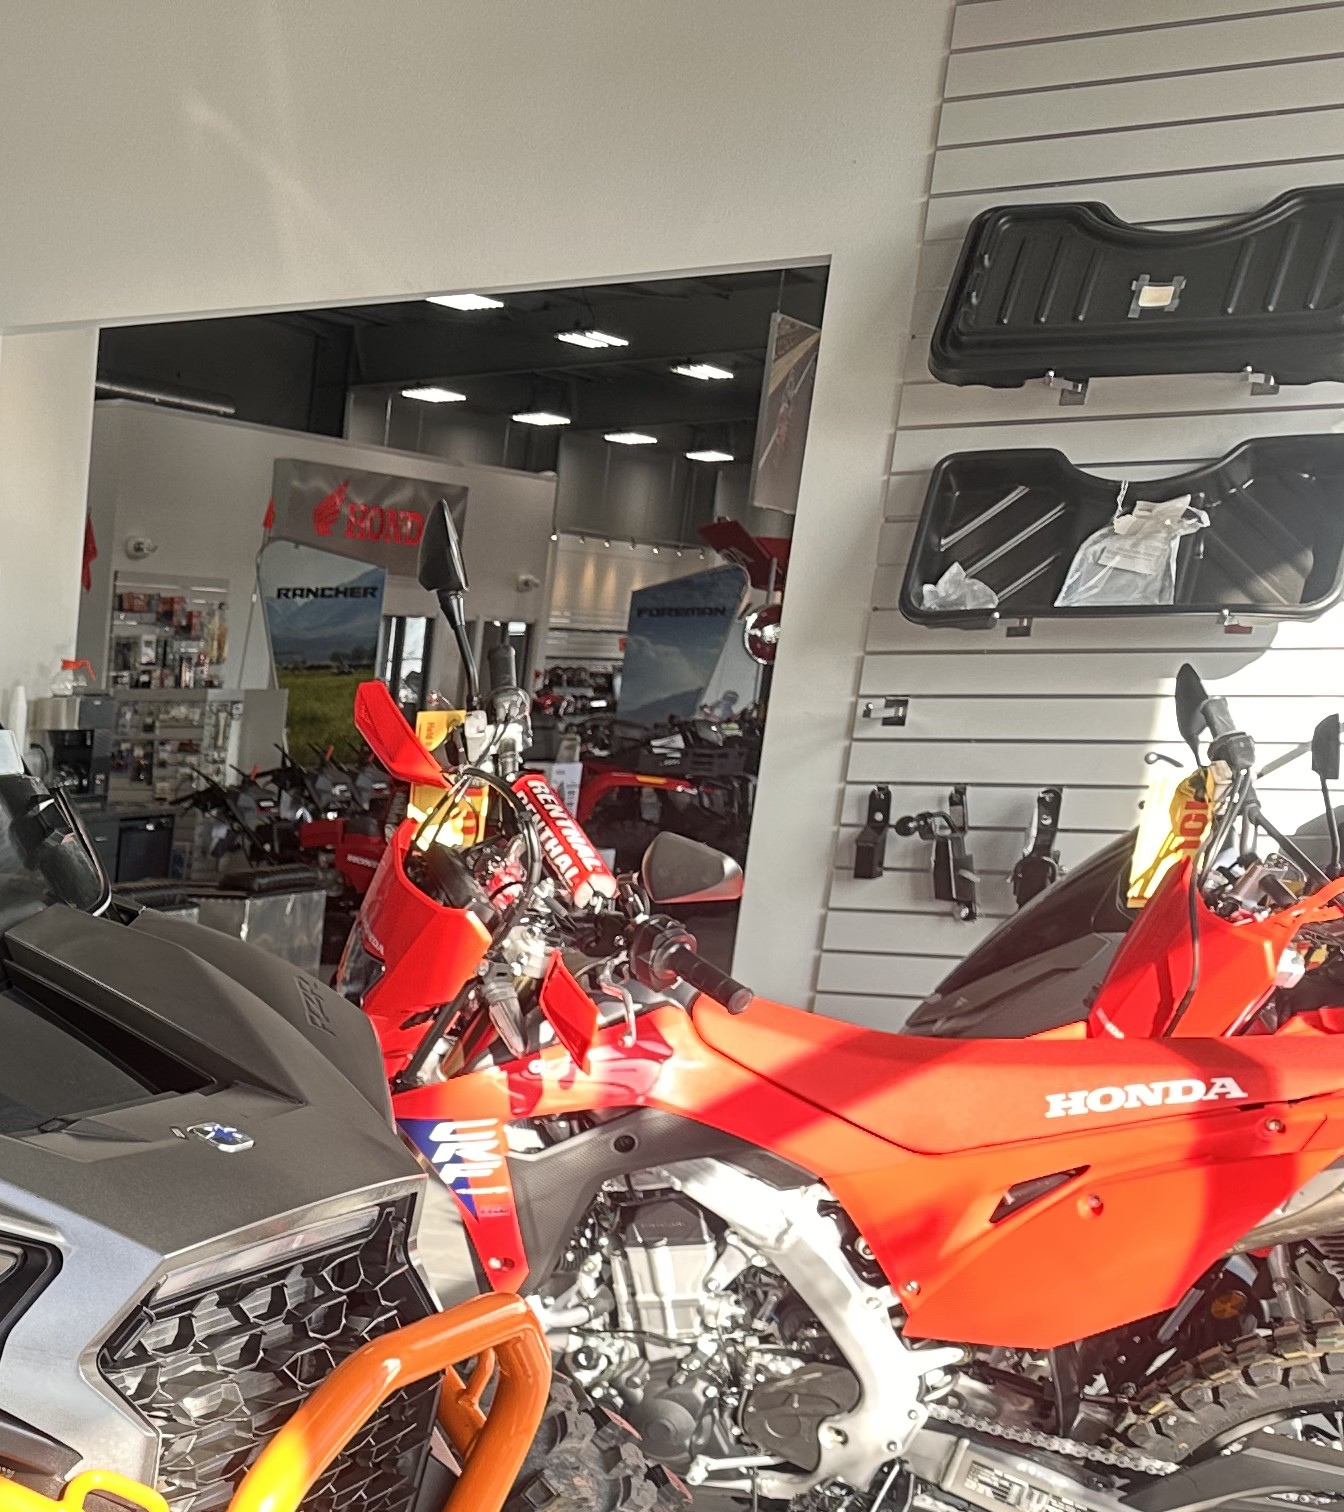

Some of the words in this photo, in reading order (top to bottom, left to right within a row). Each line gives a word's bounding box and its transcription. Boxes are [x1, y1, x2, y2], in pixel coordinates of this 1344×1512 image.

[344, 502, 427, 546] HOND
[276, 586, 379, 599] RANCHER
[636, 606, 726, 618] FOREMAN
[527, 779, 603, 872] RENTHAL
[1045, 1077, 1248, 1118] HONDA
